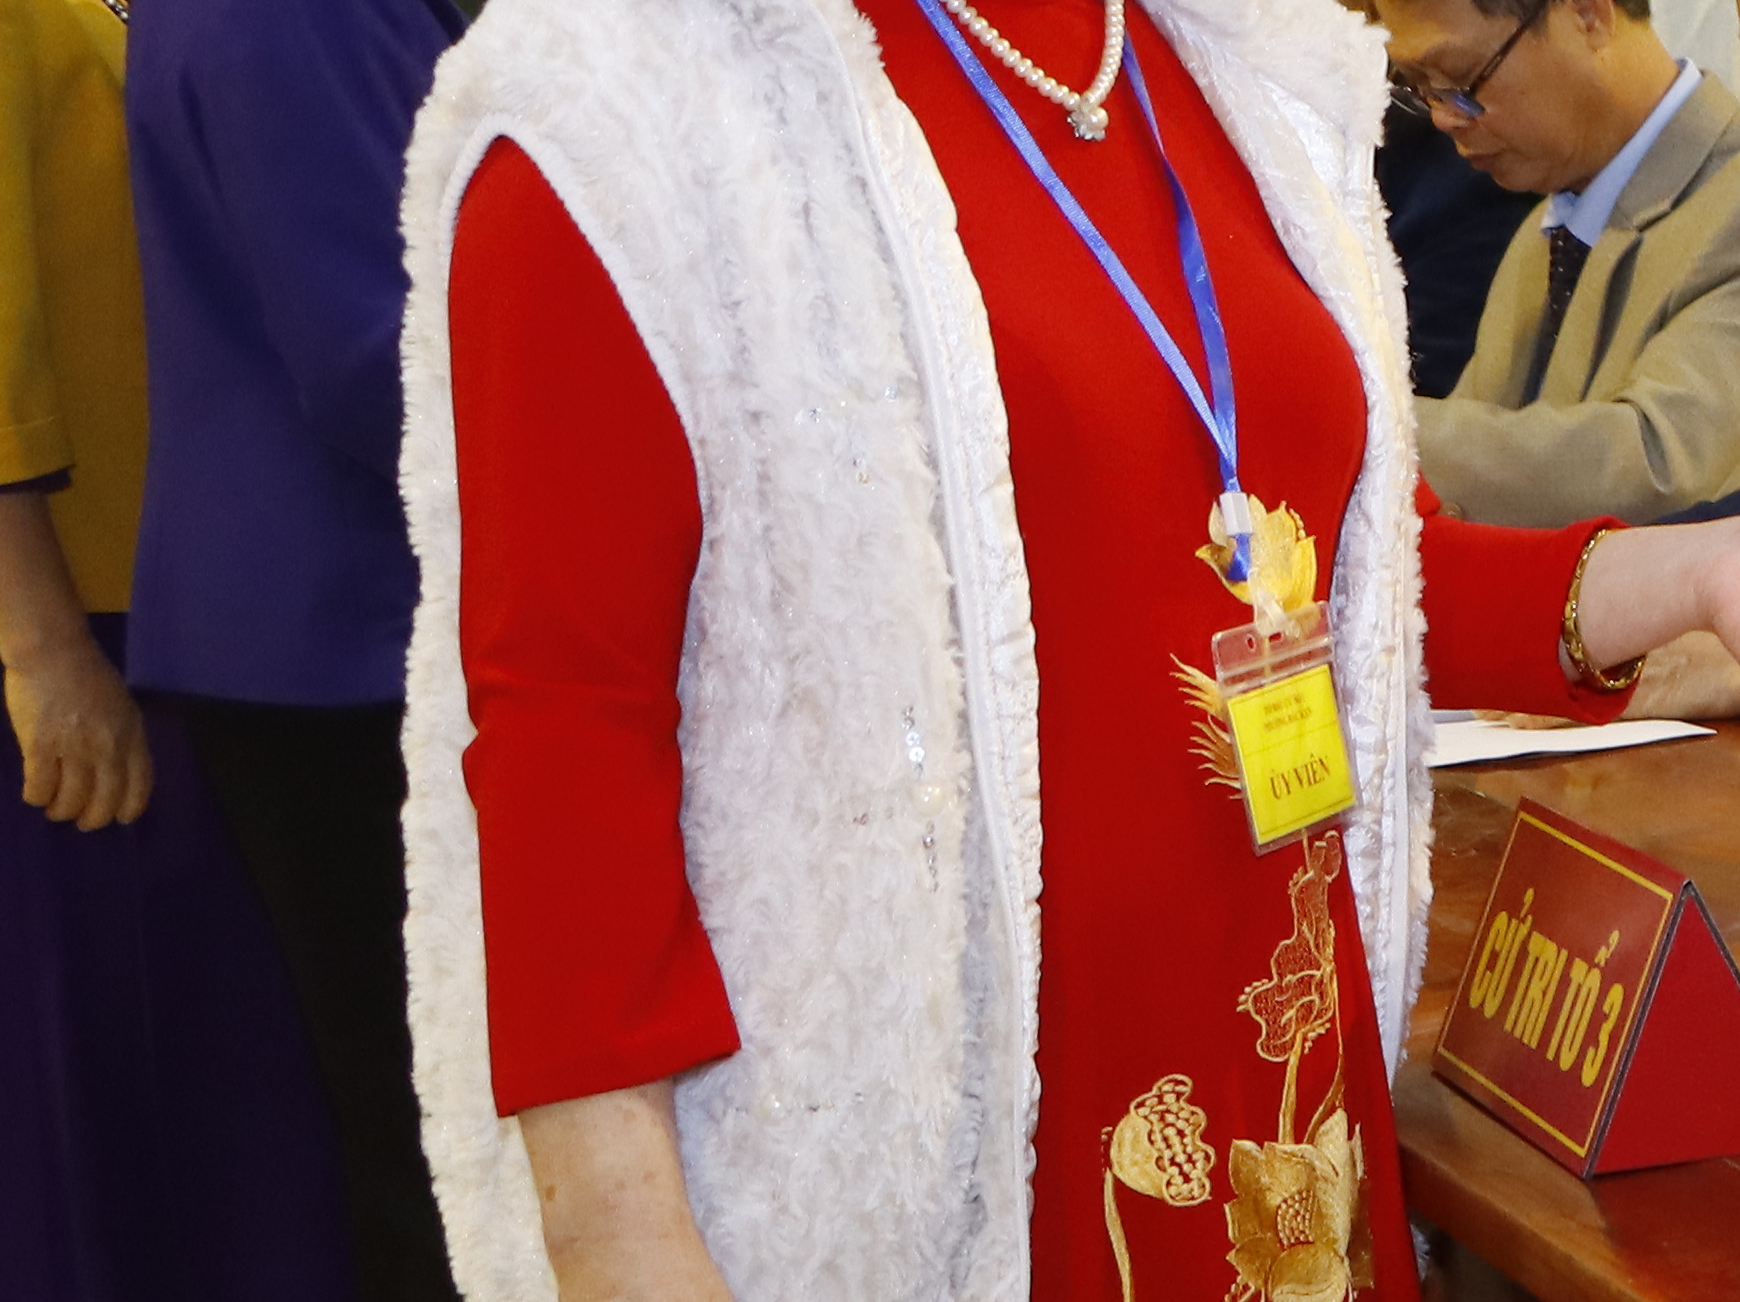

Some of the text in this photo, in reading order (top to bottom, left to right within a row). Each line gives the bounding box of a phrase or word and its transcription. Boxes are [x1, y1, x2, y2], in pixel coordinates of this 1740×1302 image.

[1293, 753, 1331, 788] VIÊN
[1469, 887, 1624, 1088] CỬ TRI TỔ 3
